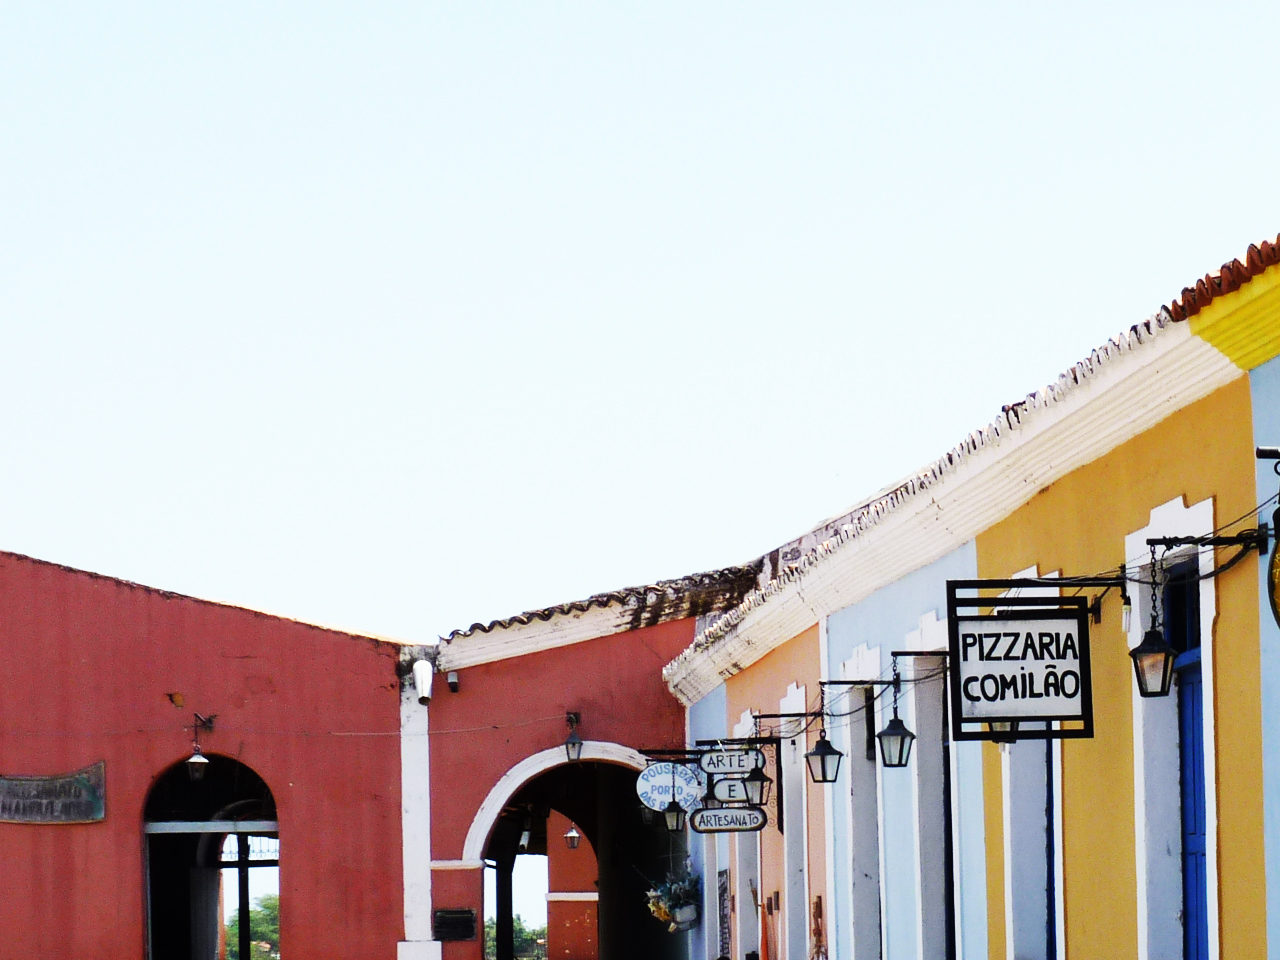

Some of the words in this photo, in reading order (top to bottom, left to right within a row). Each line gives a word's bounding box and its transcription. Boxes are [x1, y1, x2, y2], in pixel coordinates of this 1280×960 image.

[961, 631, 1079, 662] PIZZARIA
[707, 754, 745, 769] ARTE
[728, 784, 736, 798] E
[659, 792, 695, 811] BCAS
